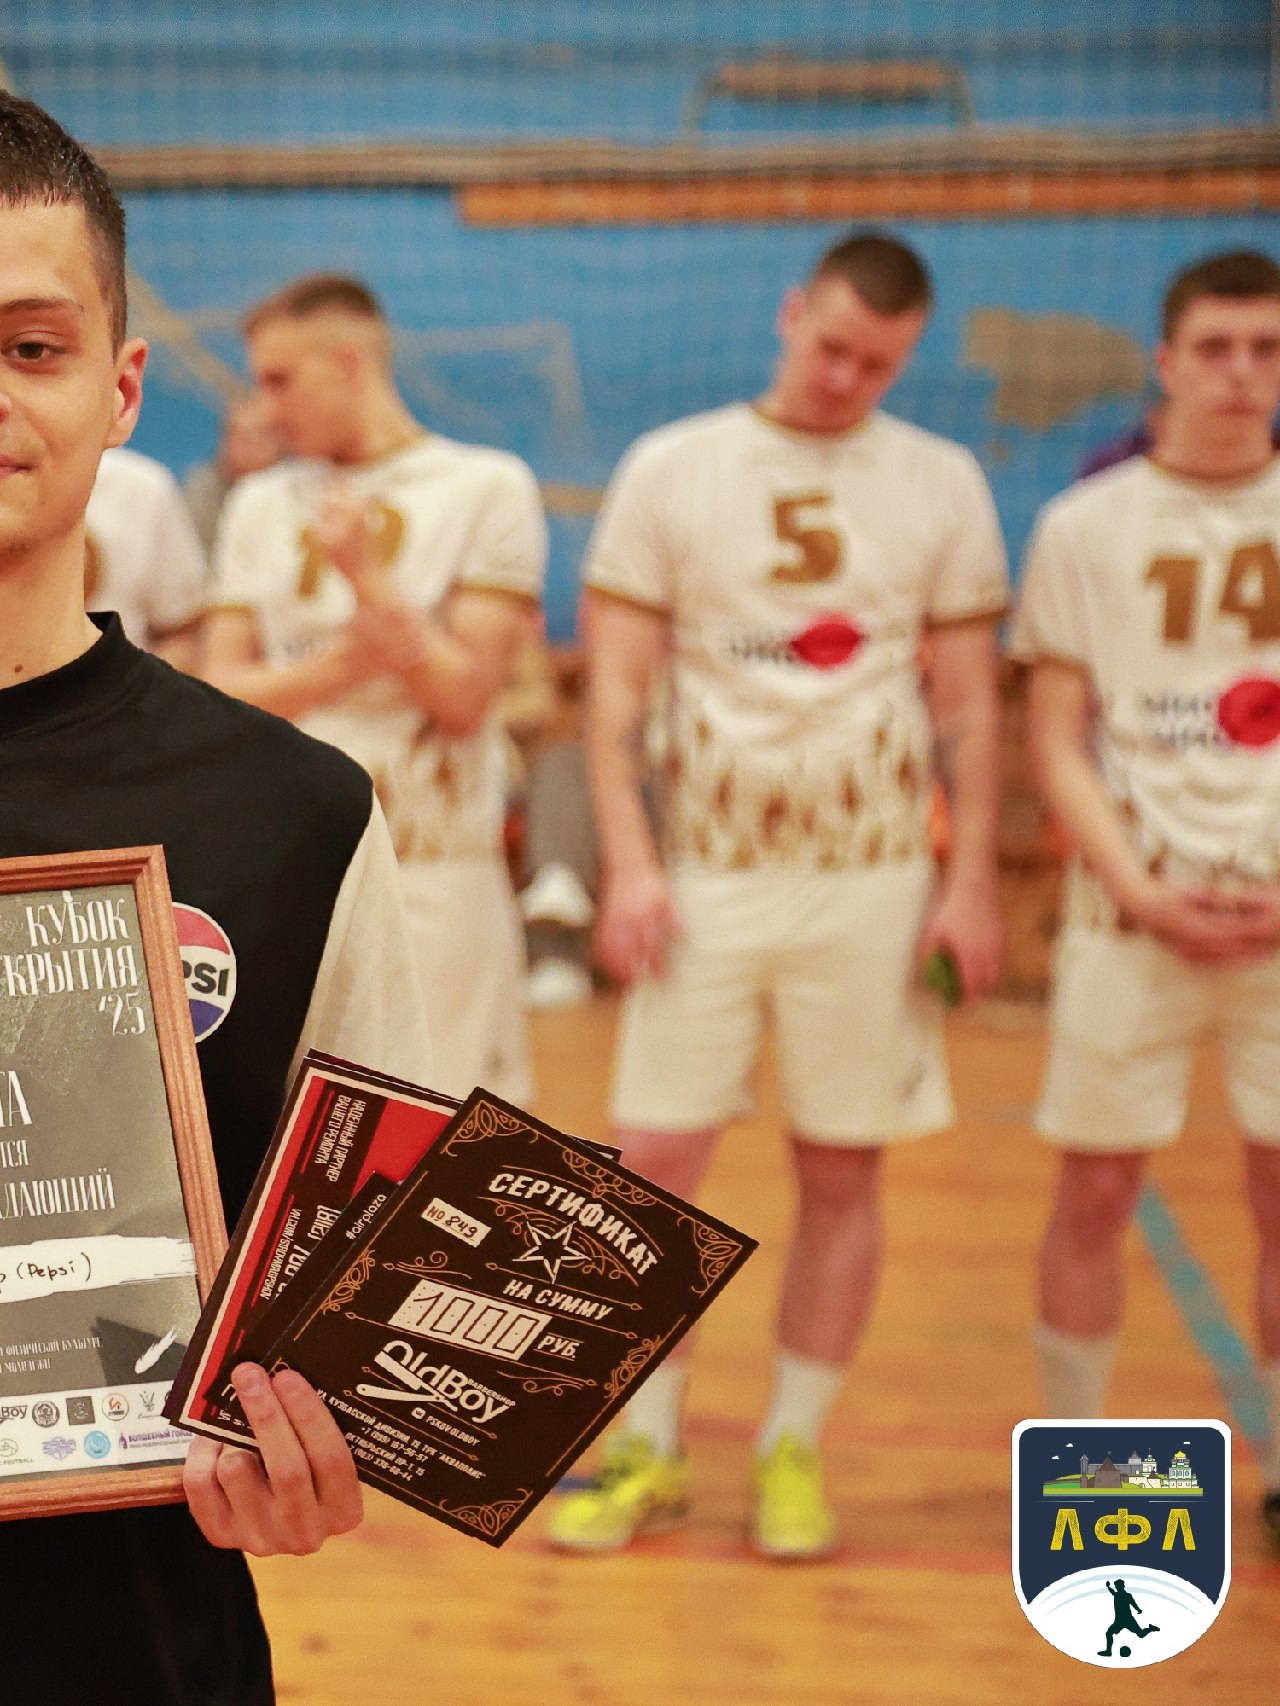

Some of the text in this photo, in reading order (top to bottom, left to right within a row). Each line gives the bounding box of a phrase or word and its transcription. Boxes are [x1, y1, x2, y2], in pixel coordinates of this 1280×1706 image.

[769, 492, 844, 585] 5
[1144, 543, 1280, 642] 14
[25, 897, 131, 947] КУБОК
[488, 1172, 658, 1276] СЕРТИФИКАТ
[413, 1291, 540, 1355] 1000
[503, 1279, 613, 1321] НА СУММУ
[537, 1334, 580, 1359] РУБ.
